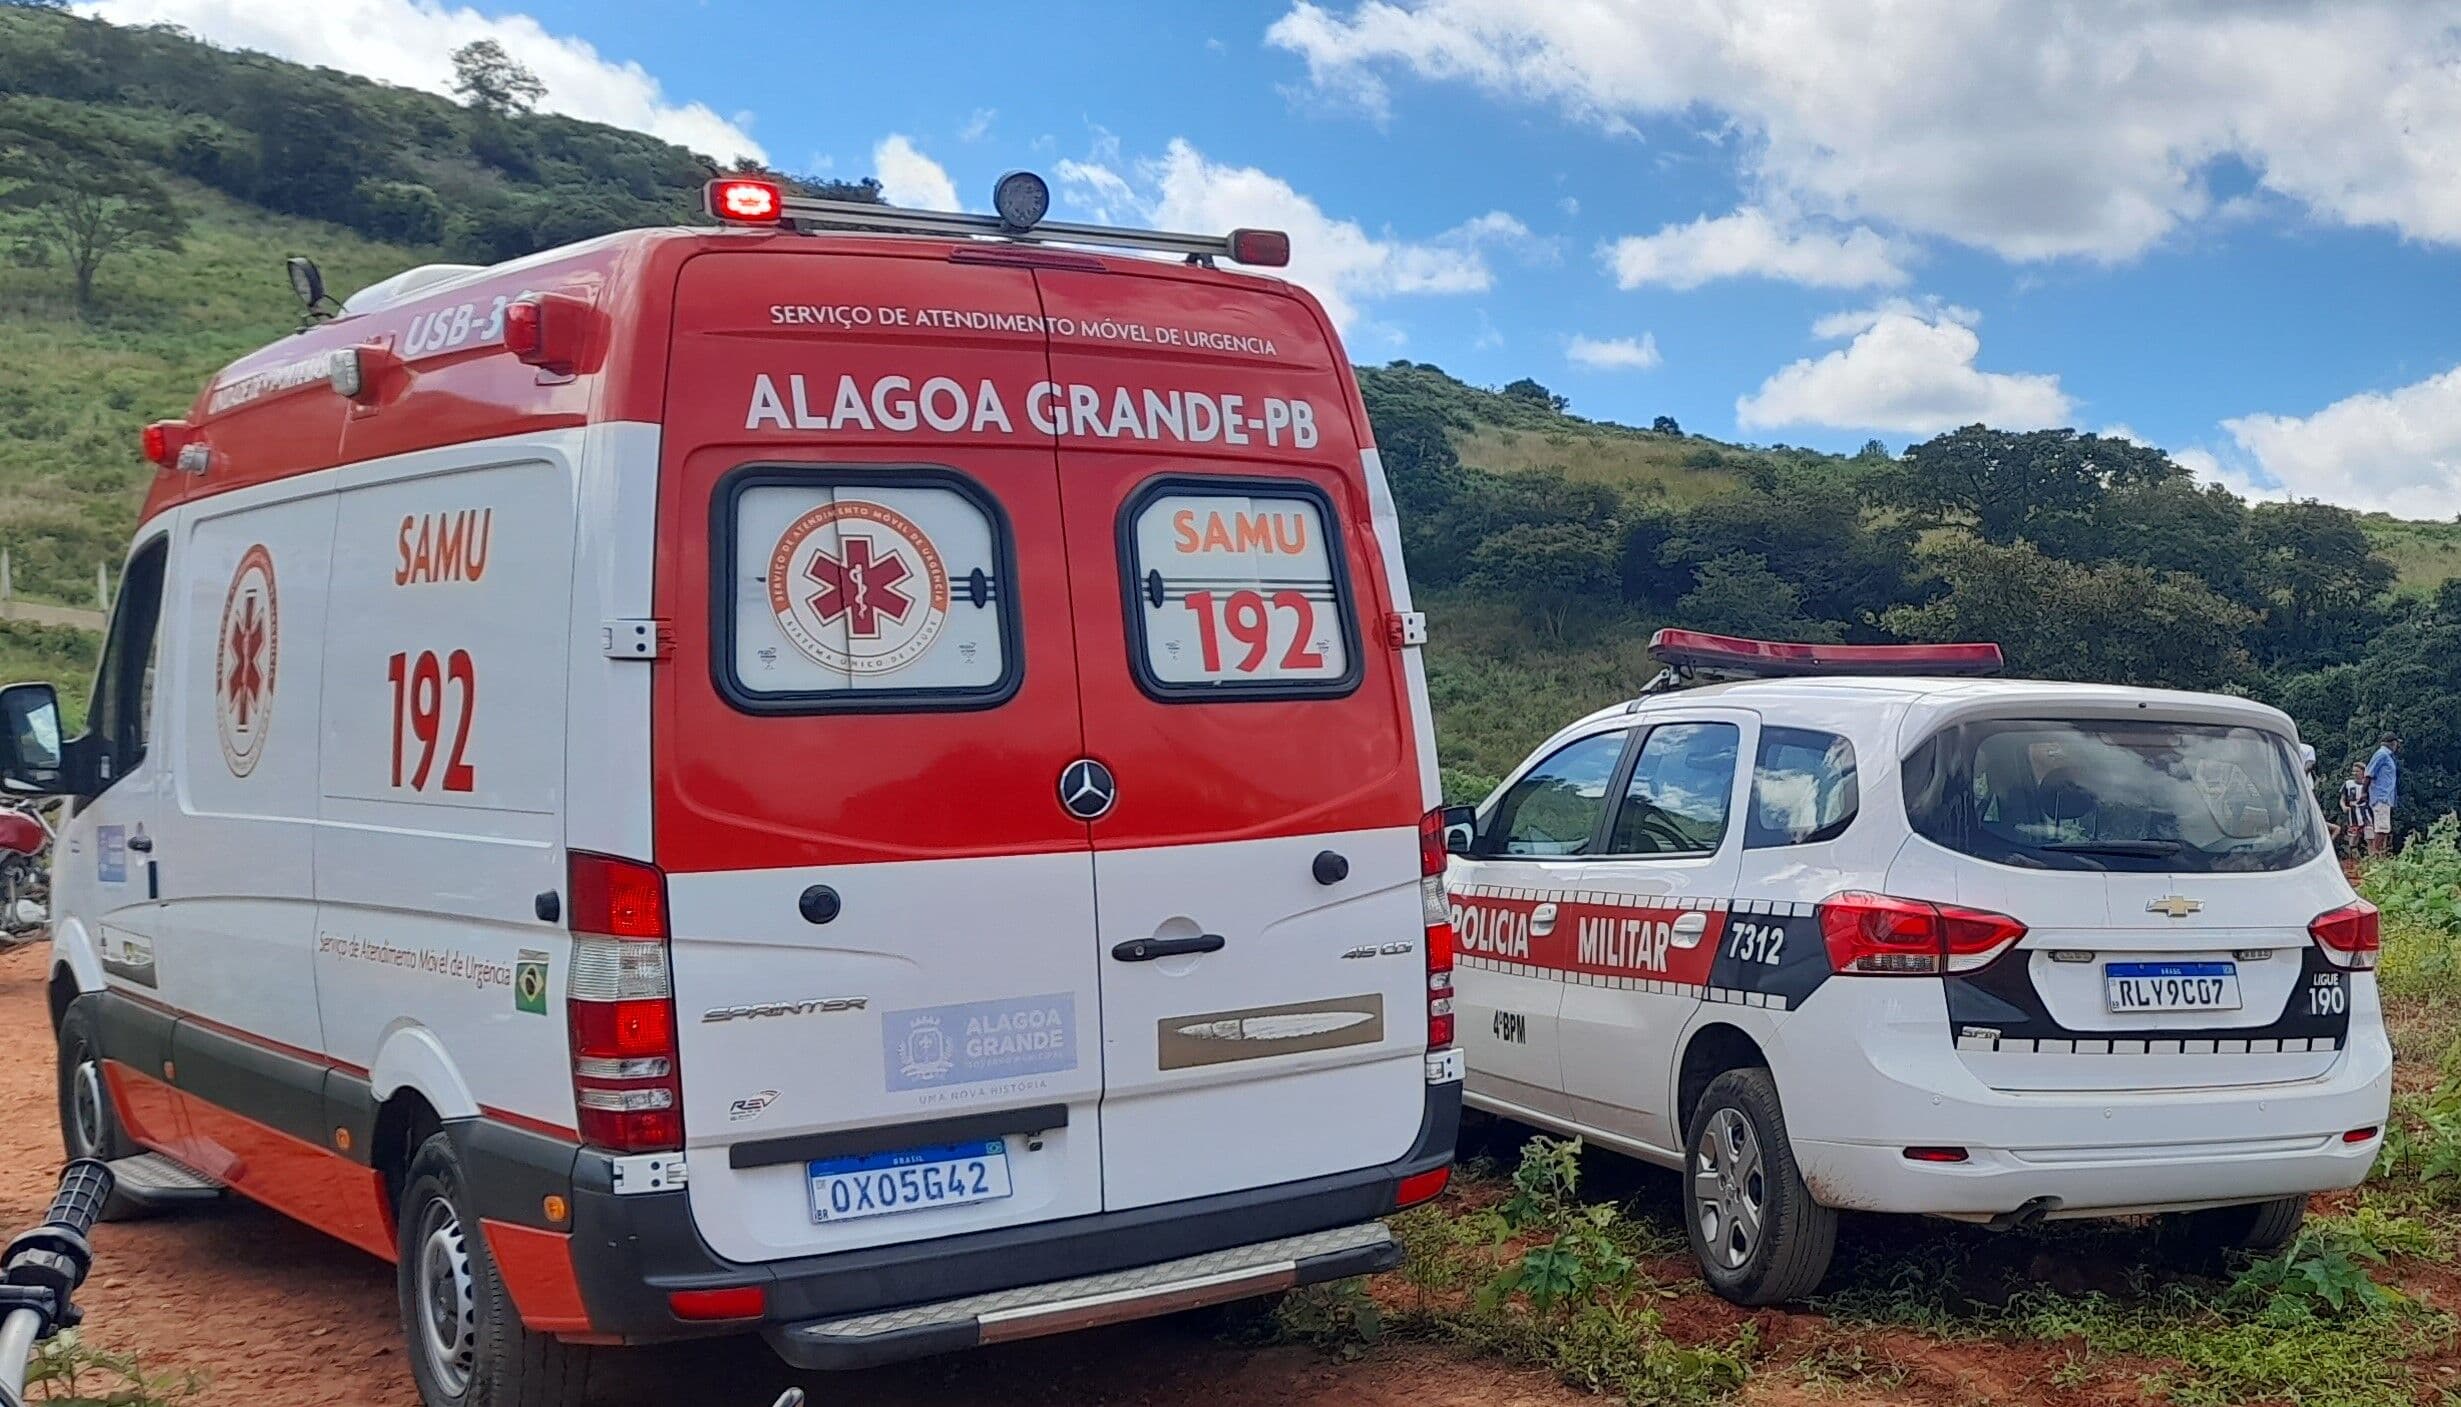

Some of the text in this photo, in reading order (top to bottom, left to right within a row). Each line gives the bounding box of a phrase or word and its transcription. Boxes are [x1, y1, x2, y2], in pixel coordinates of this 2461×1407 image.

[769, 305, 1278, 356] SERVIÇO DE ATENDIMENTO MÓVEL DE URGENCIA
[744, 373, 1319, 450] ALAGOA GRANDE-PB
[394, 507, 494, 587] SAMU
[1173, 510, 1306, 555] SAMU
[1184, 588, 1324, 673] 192
[387, 648, 476, 793] 192
[1450, 903, 1669, 973] POLICIA MILITAR
[1729, 921, 1785, 966] 7312
[2308, 986, 2346, 1017] 190
[2314, 972, 2340, 986] LIGUE
[701, 995, 869, 1024] SPRINTER
[965, 1007, 1063, 1036] ALAGOA
[965, 1028, 1065, 1058] GRANDE
